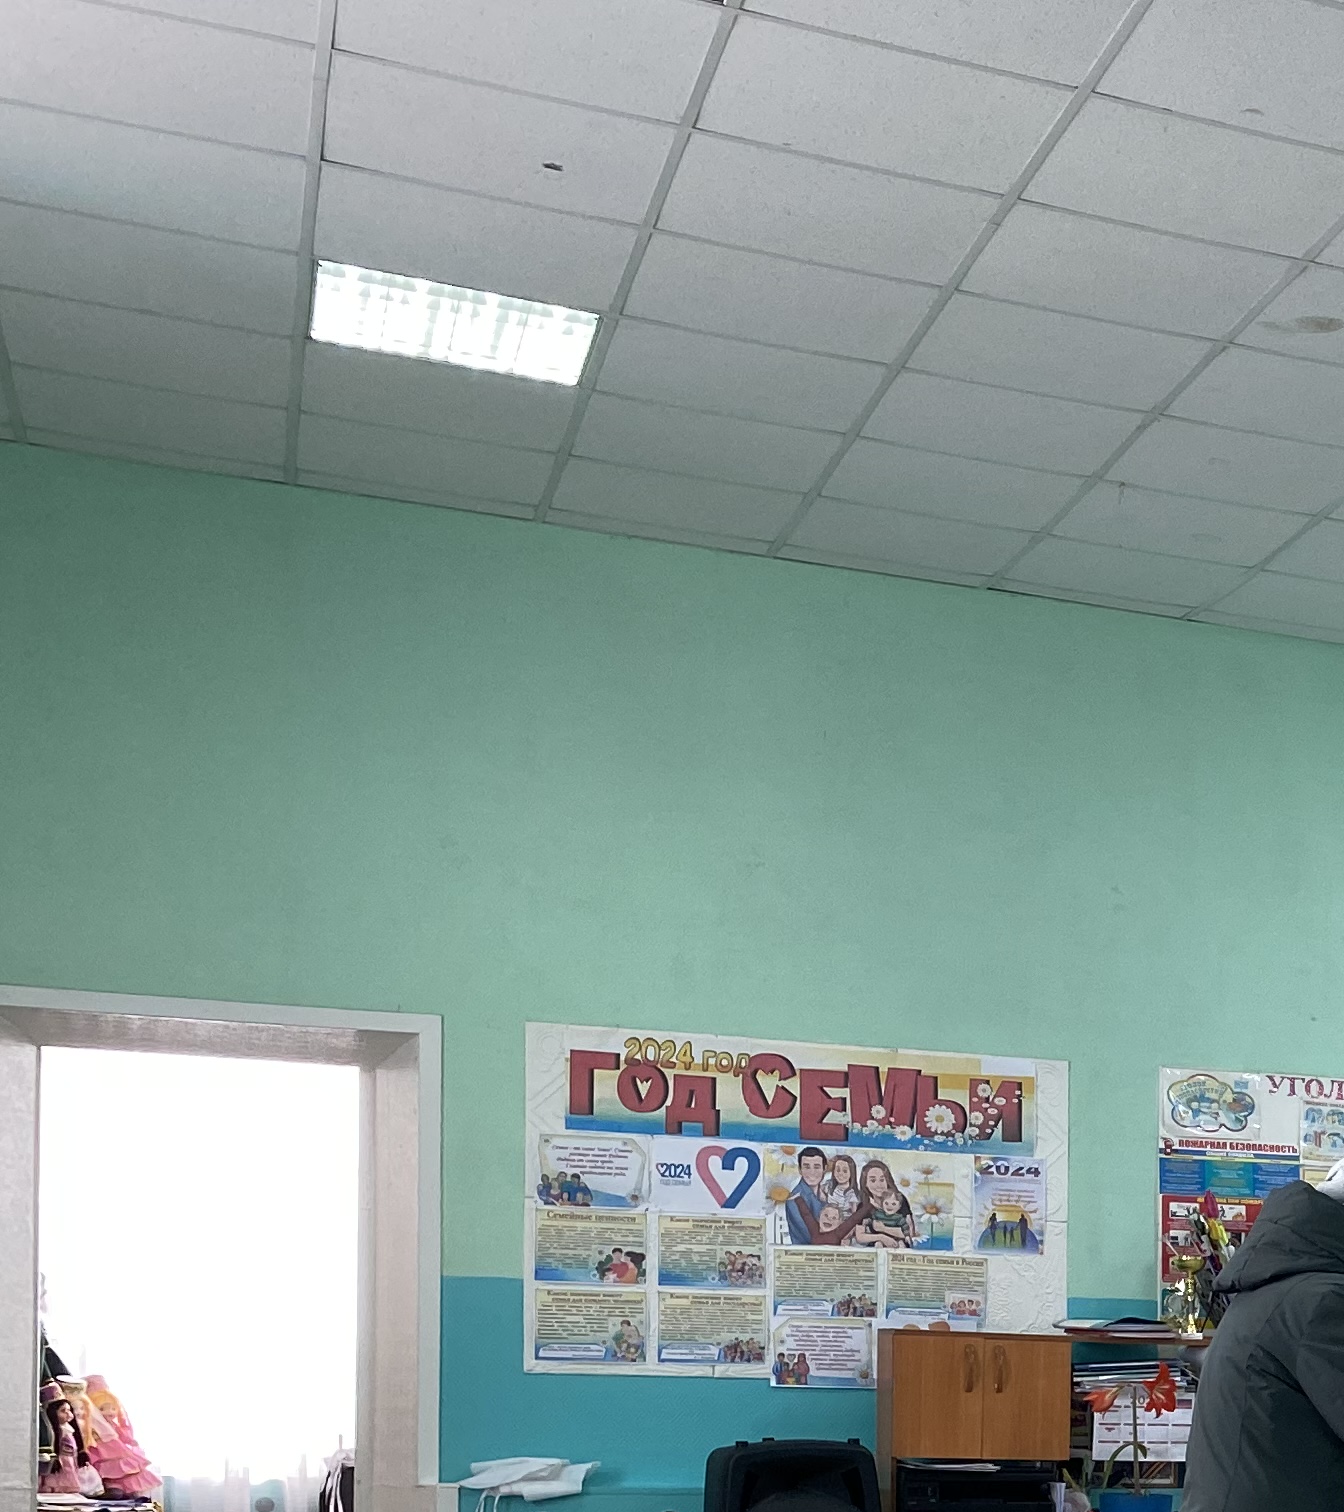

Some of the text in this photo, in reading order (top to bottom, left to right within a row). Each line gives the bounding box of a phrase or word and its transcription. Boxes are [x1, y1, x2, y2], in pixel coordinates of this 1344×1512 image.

[624, 1037, 752, 1078] 2024 год
[742, 1053, 1023, 1143] СЕМЬИ
[1178, 1139, 1298, 1154] ПОЖАРНАЯ БЕЗОПАСНОСТЬ
[661, 1163, 692, 1179] 2024
[980, 1160, 1041, 1178] 2024
